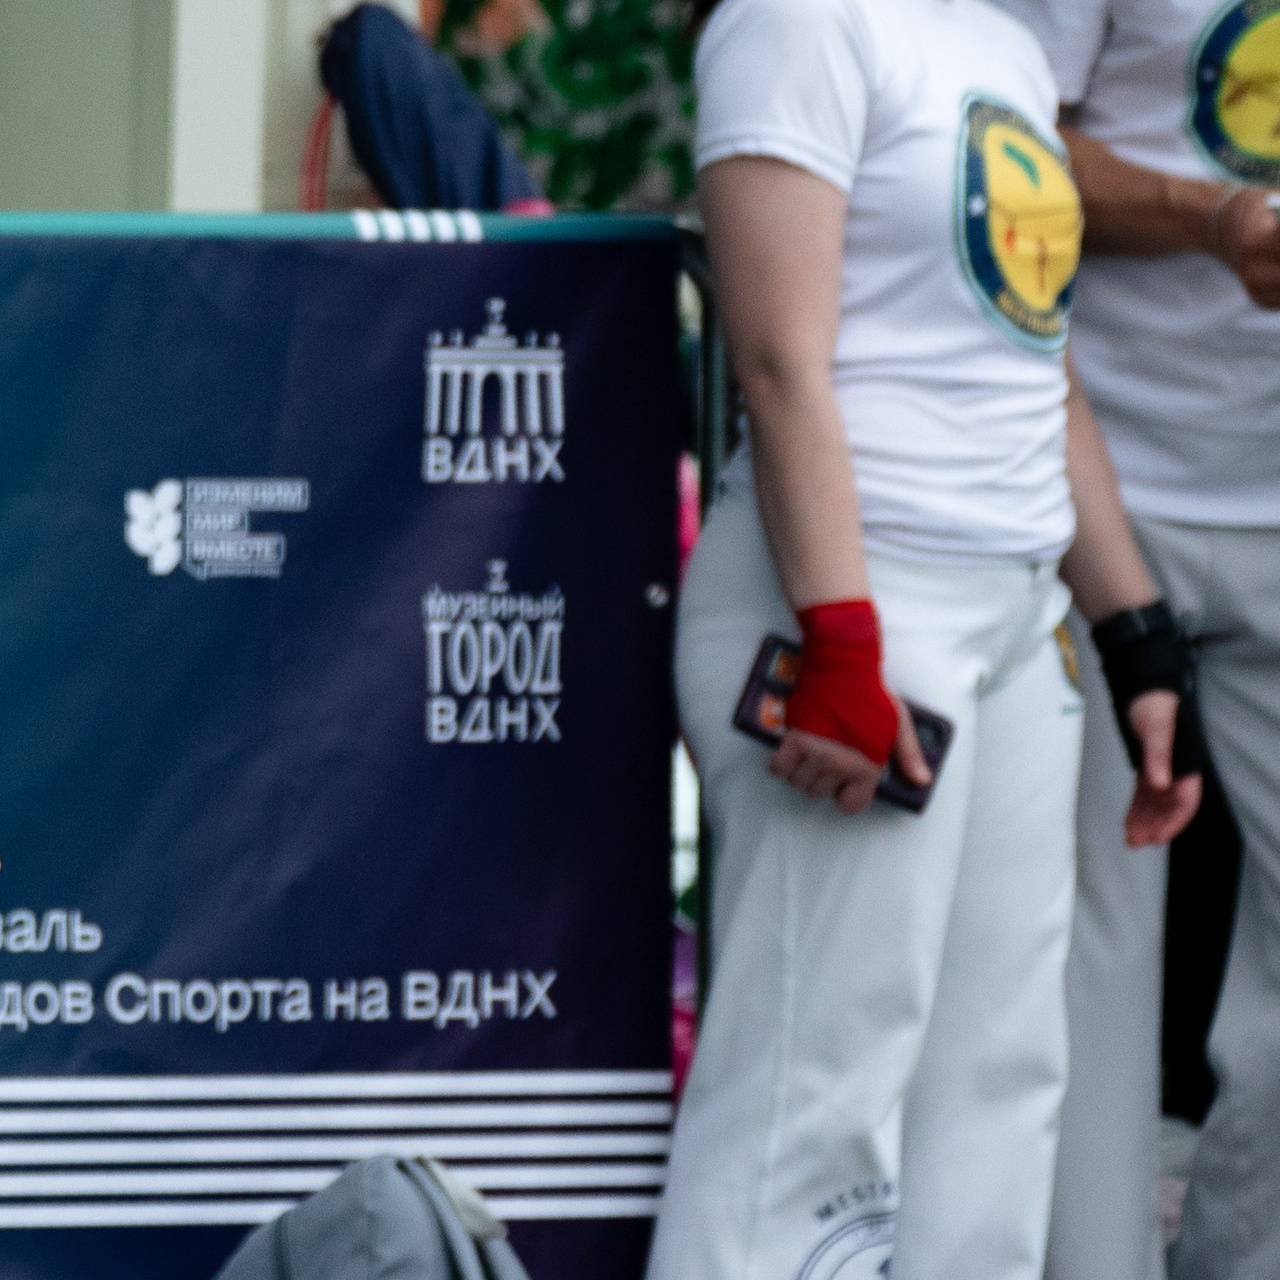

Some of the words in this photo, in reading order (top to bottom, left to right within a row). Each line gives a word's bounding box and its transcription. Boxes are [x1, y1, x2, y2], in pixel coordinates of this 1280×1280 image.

[423, 436, 565, 483] ВДНХ
[425, 621, 564, 695] ГОРОД
[425, 696, 563, 743] ВДНХ
[105, 972, 313, 1032] Спорта
[325, 978, 390, 1022] на
[403, 970, 558, 1029] ВДНХ
